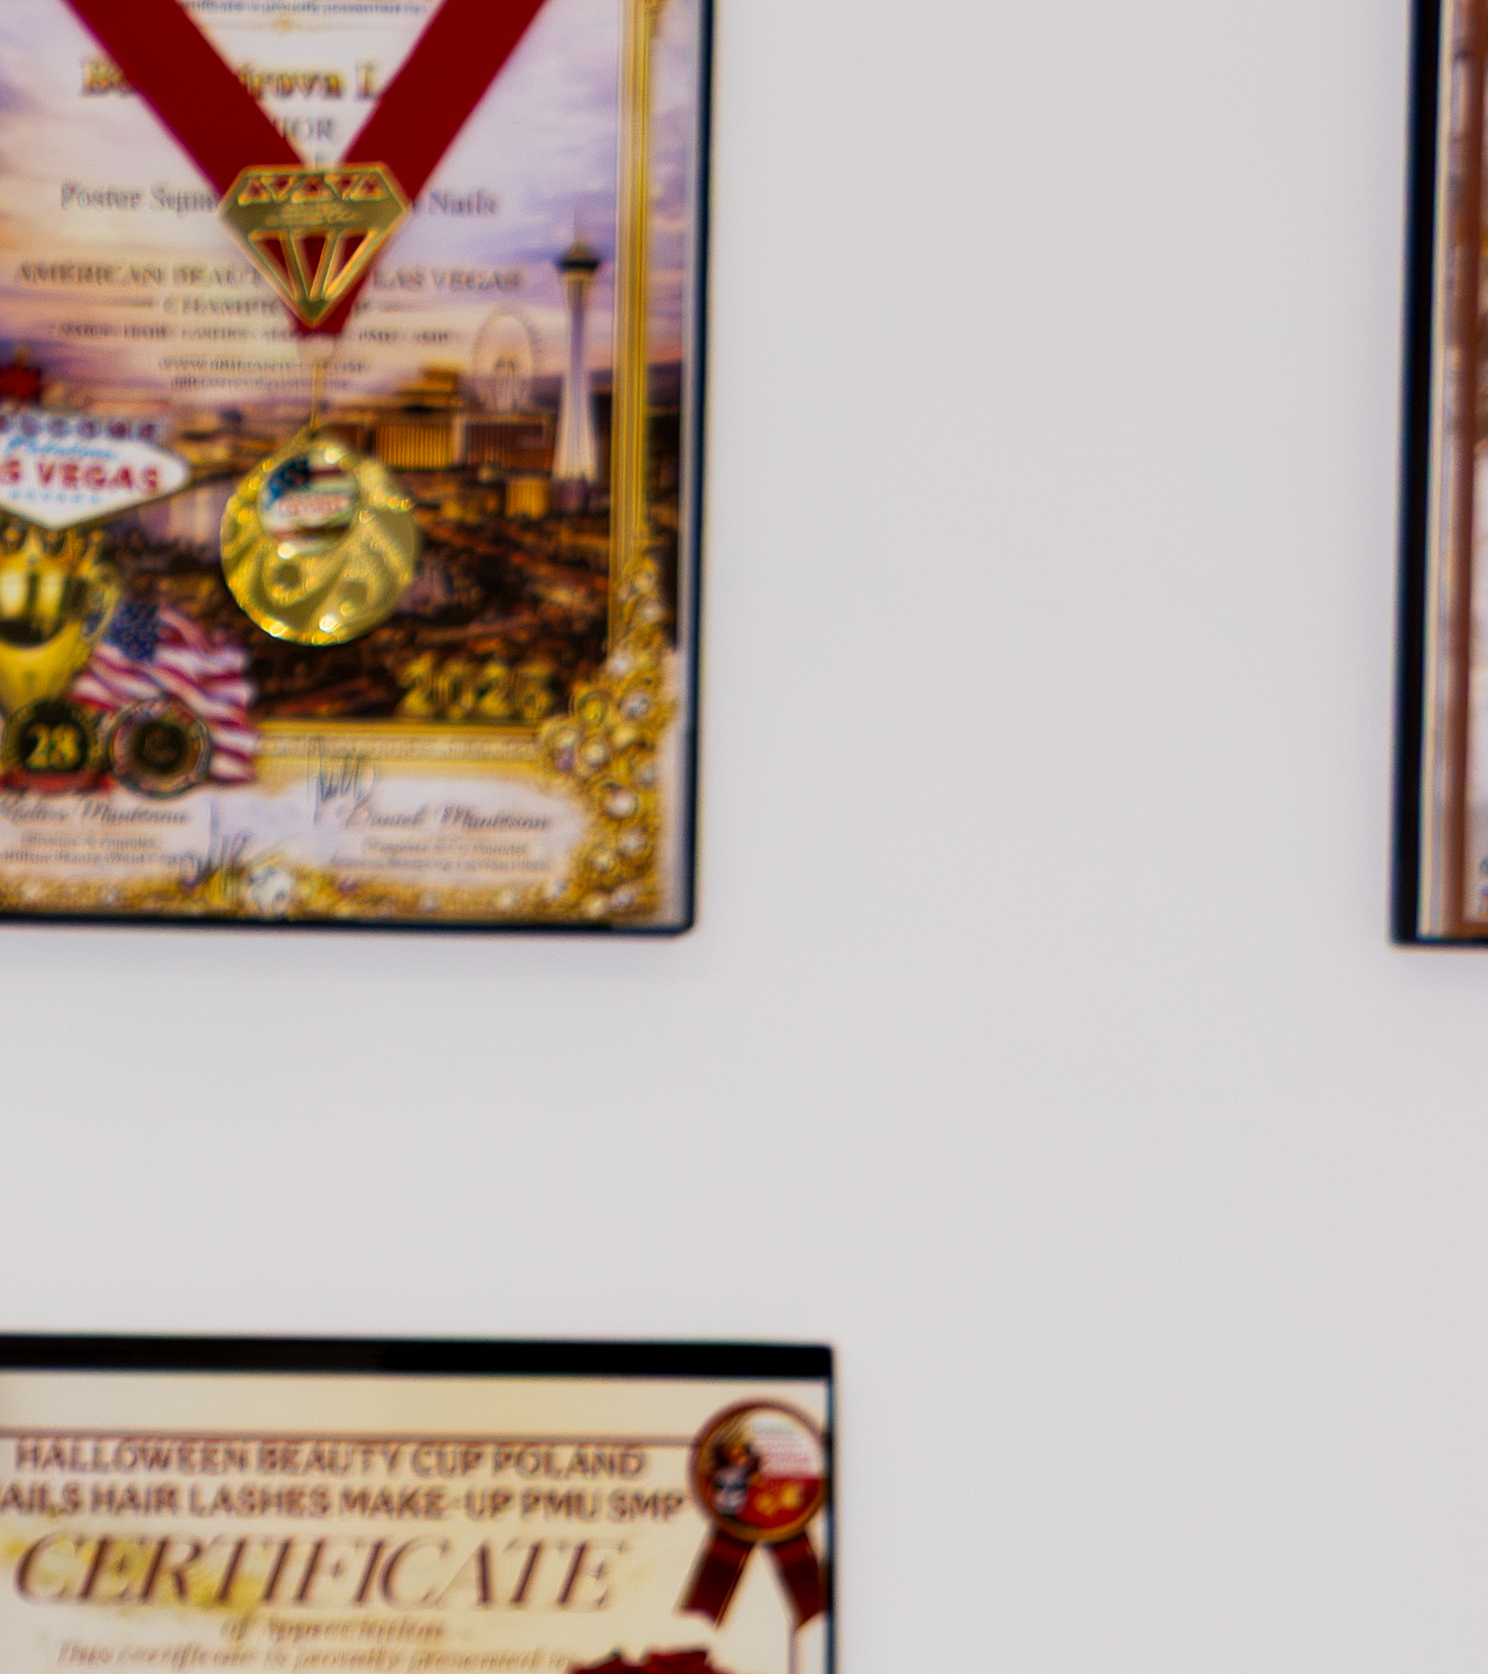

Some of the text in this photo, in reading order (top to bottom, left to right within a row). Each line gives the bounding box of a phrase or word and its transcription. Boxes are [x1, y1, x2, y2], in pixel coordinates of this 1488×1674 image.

[37, 459, 158, 496] VEGAS
[14, 1437, 648, 1479] HALLOWEEN BEAUTY CUP POLAND
[92, 1485, 179, 1516] HAIR
[189, 1485, 331, 1518] LASHES
[522, 1489, 600, 1521] PMU
[610, 1490, 685, 1522] SMP
[13, 1534, 628, 1610] CERTIFICATE
